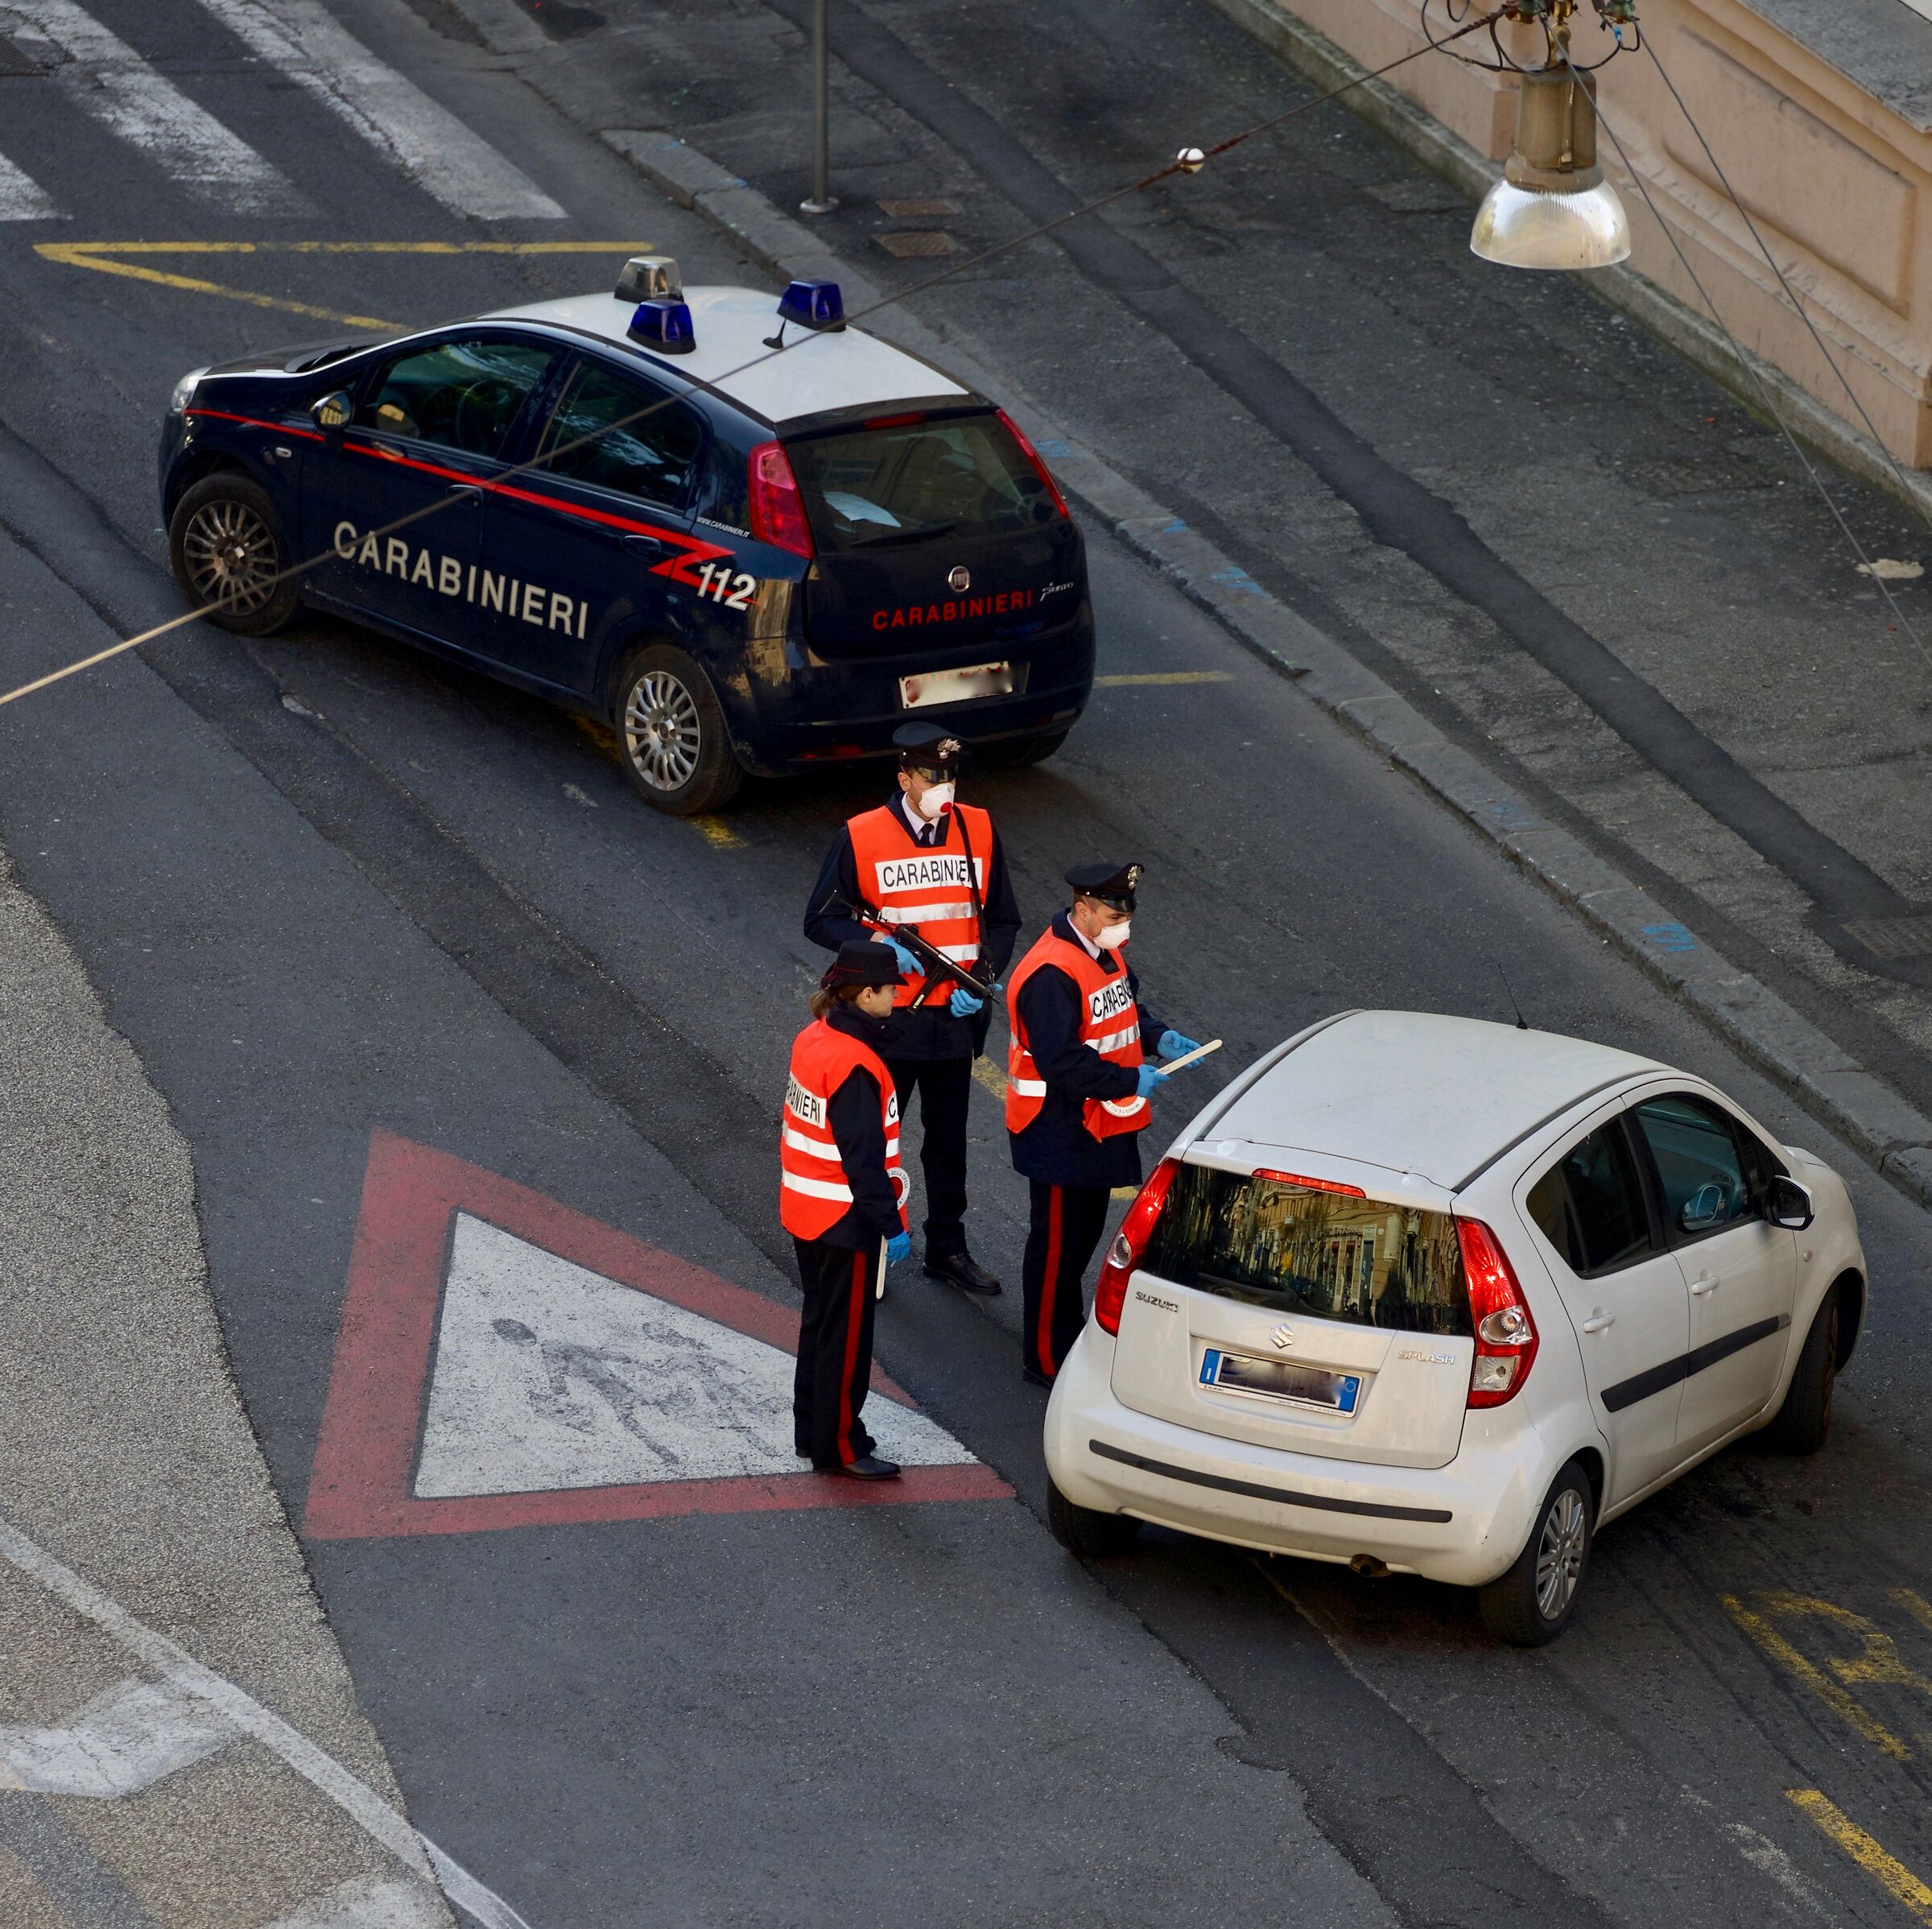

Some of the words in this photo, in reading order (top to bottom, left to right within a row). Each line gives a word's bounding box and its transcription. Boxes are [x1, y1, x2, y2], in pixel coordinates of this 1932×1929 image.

[333, 521, 588, 640] CARABINIERI
[697, 563, 756, 611] 112
[872, 589, 1032, 630] CARABINIERI
[883, 859, 976, 887] CARABINIE
[1135, 1291, 1179, 1313] SUZUKI
[1397, 1350, 1455, 1365] SPLASH
